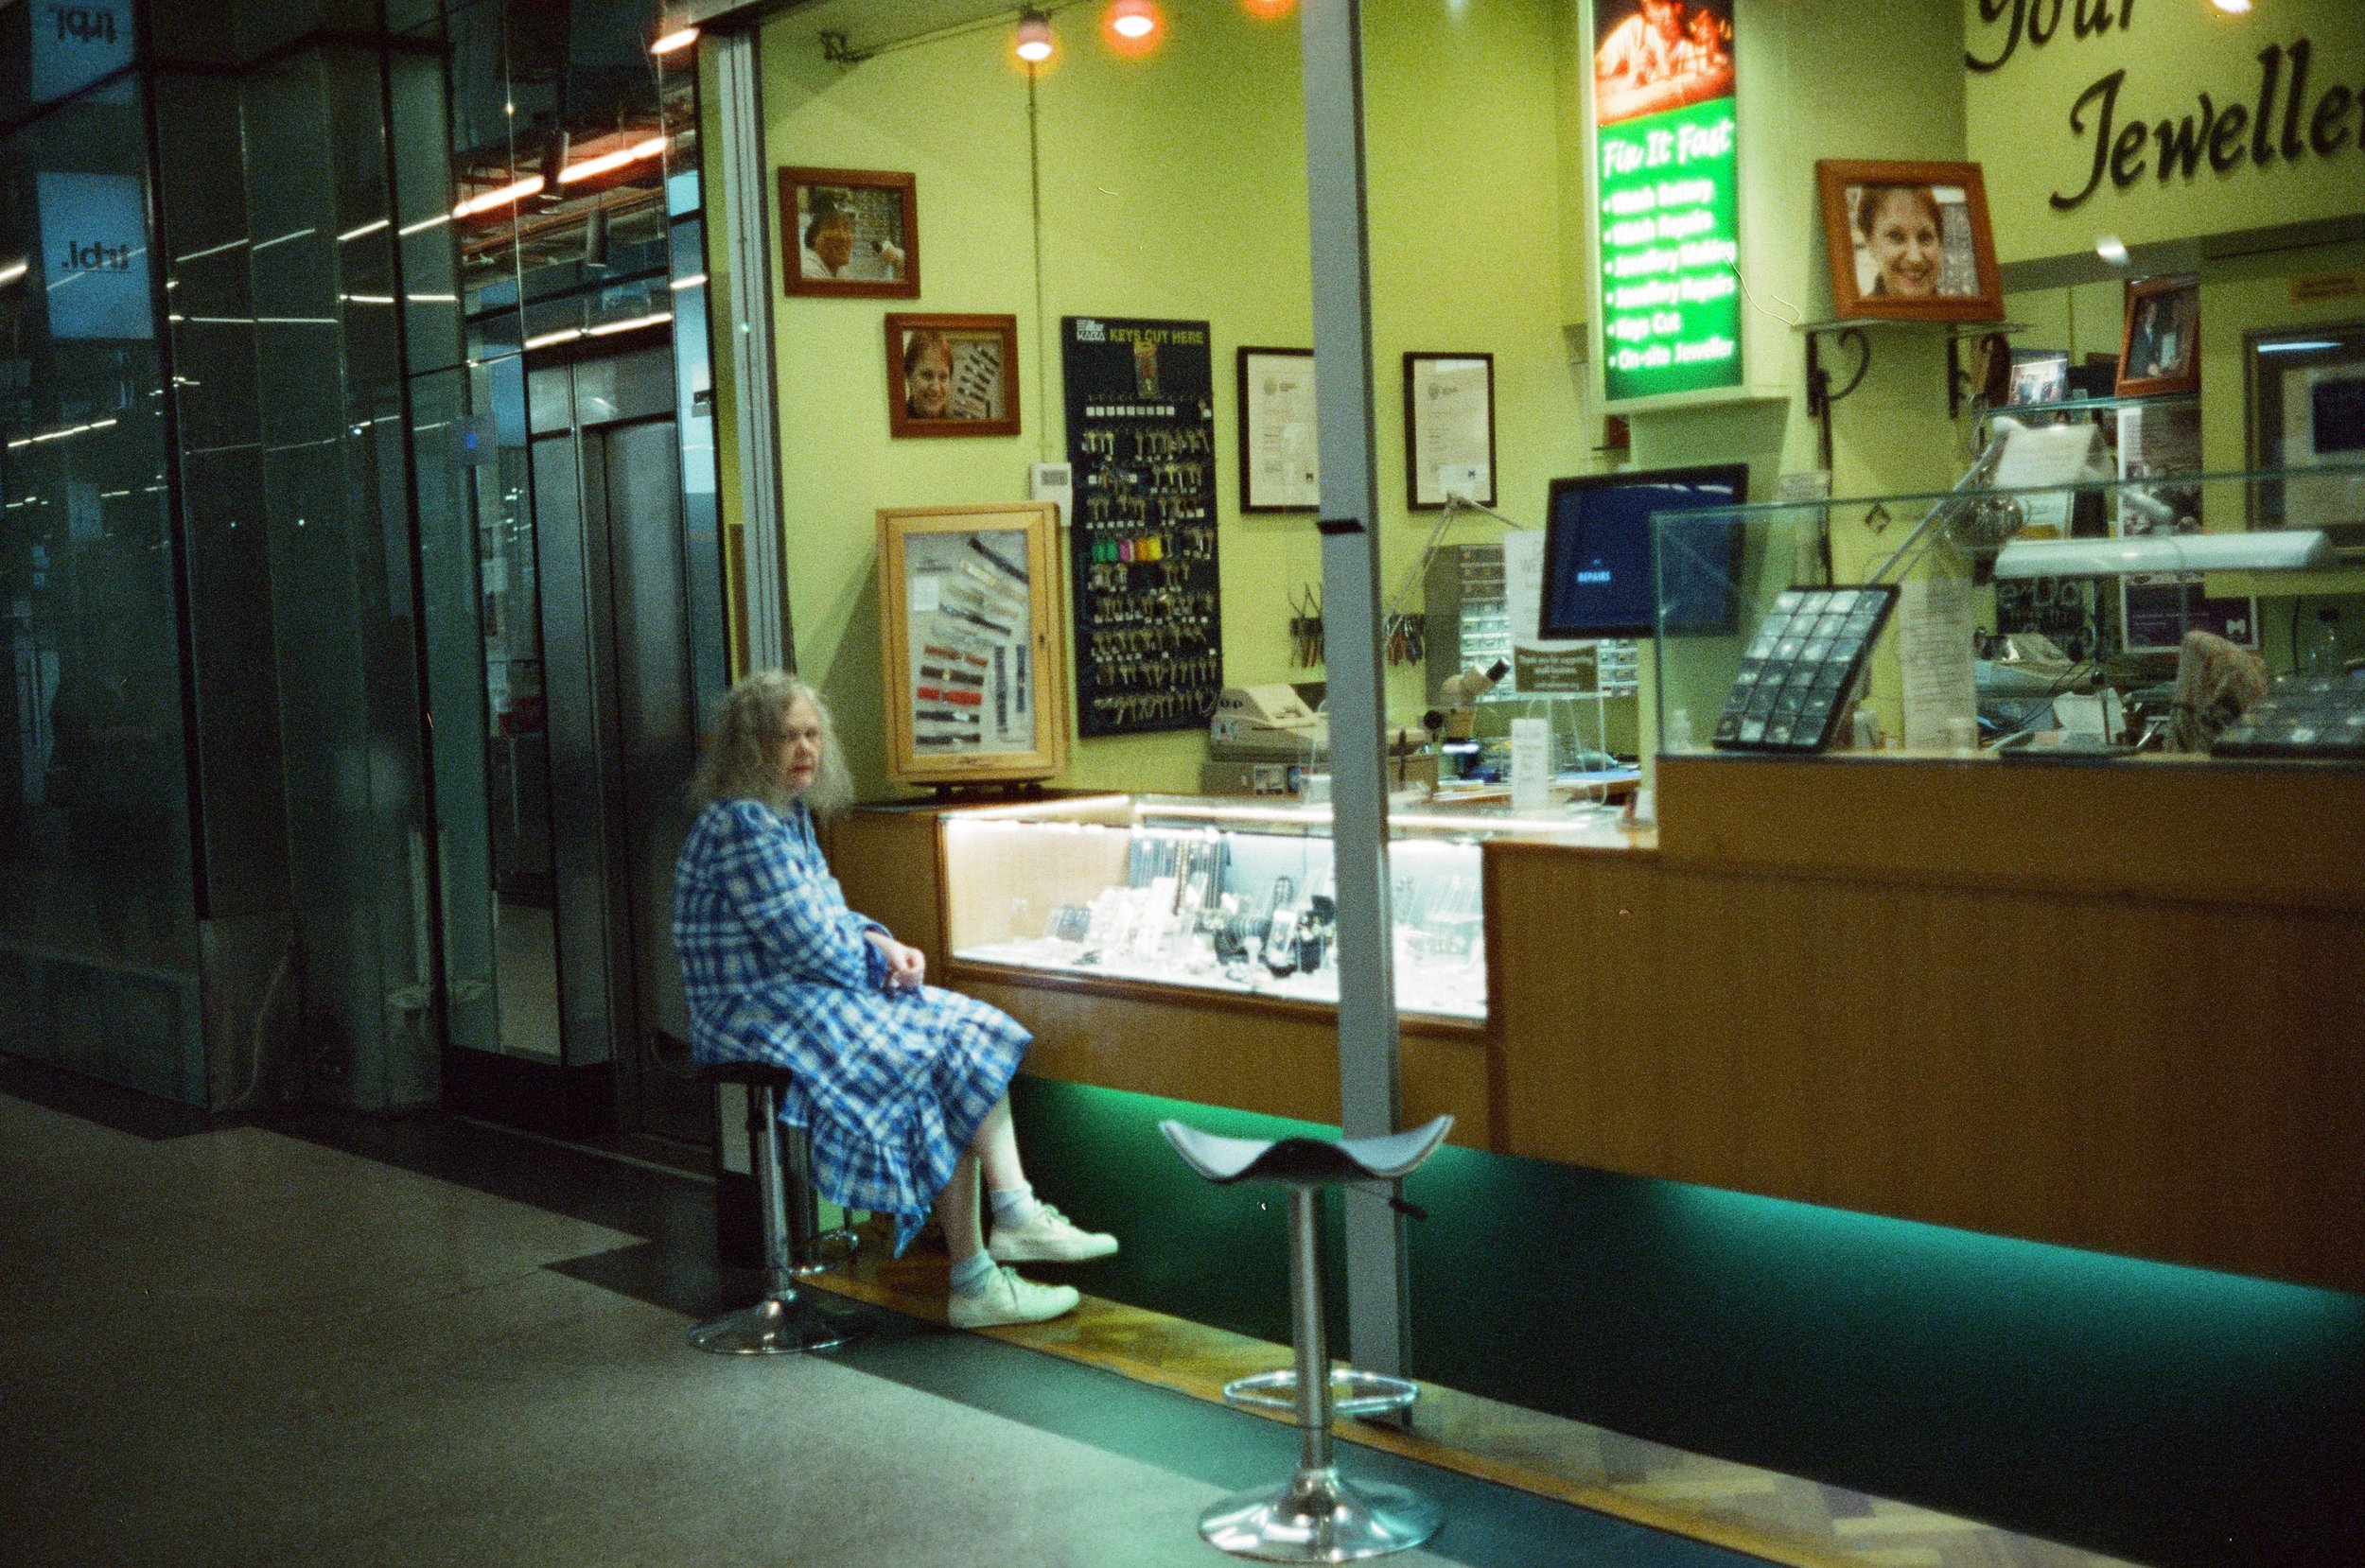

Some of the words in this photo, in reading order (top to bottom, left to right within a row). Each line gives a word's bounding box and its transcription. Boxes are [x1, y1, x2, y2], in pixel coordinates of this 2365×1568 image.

[2049, 38, 2365, 212] Jewelle
[1603, 141, 1644, 177] Fix
[1647, 131, 1673, 166] It
[1678, 120, 1732, 164] Fast
[1110, 328, 1142, 341] KEYS
[1145, 330, 1168, 343] CUT
[1616, 318, 1650, 340] Keys
[1653, 313, 1680, 333] Cut
[1619, 346, 1669, 367] On-site
[1676, 339, 1732, 361] Jeweller
